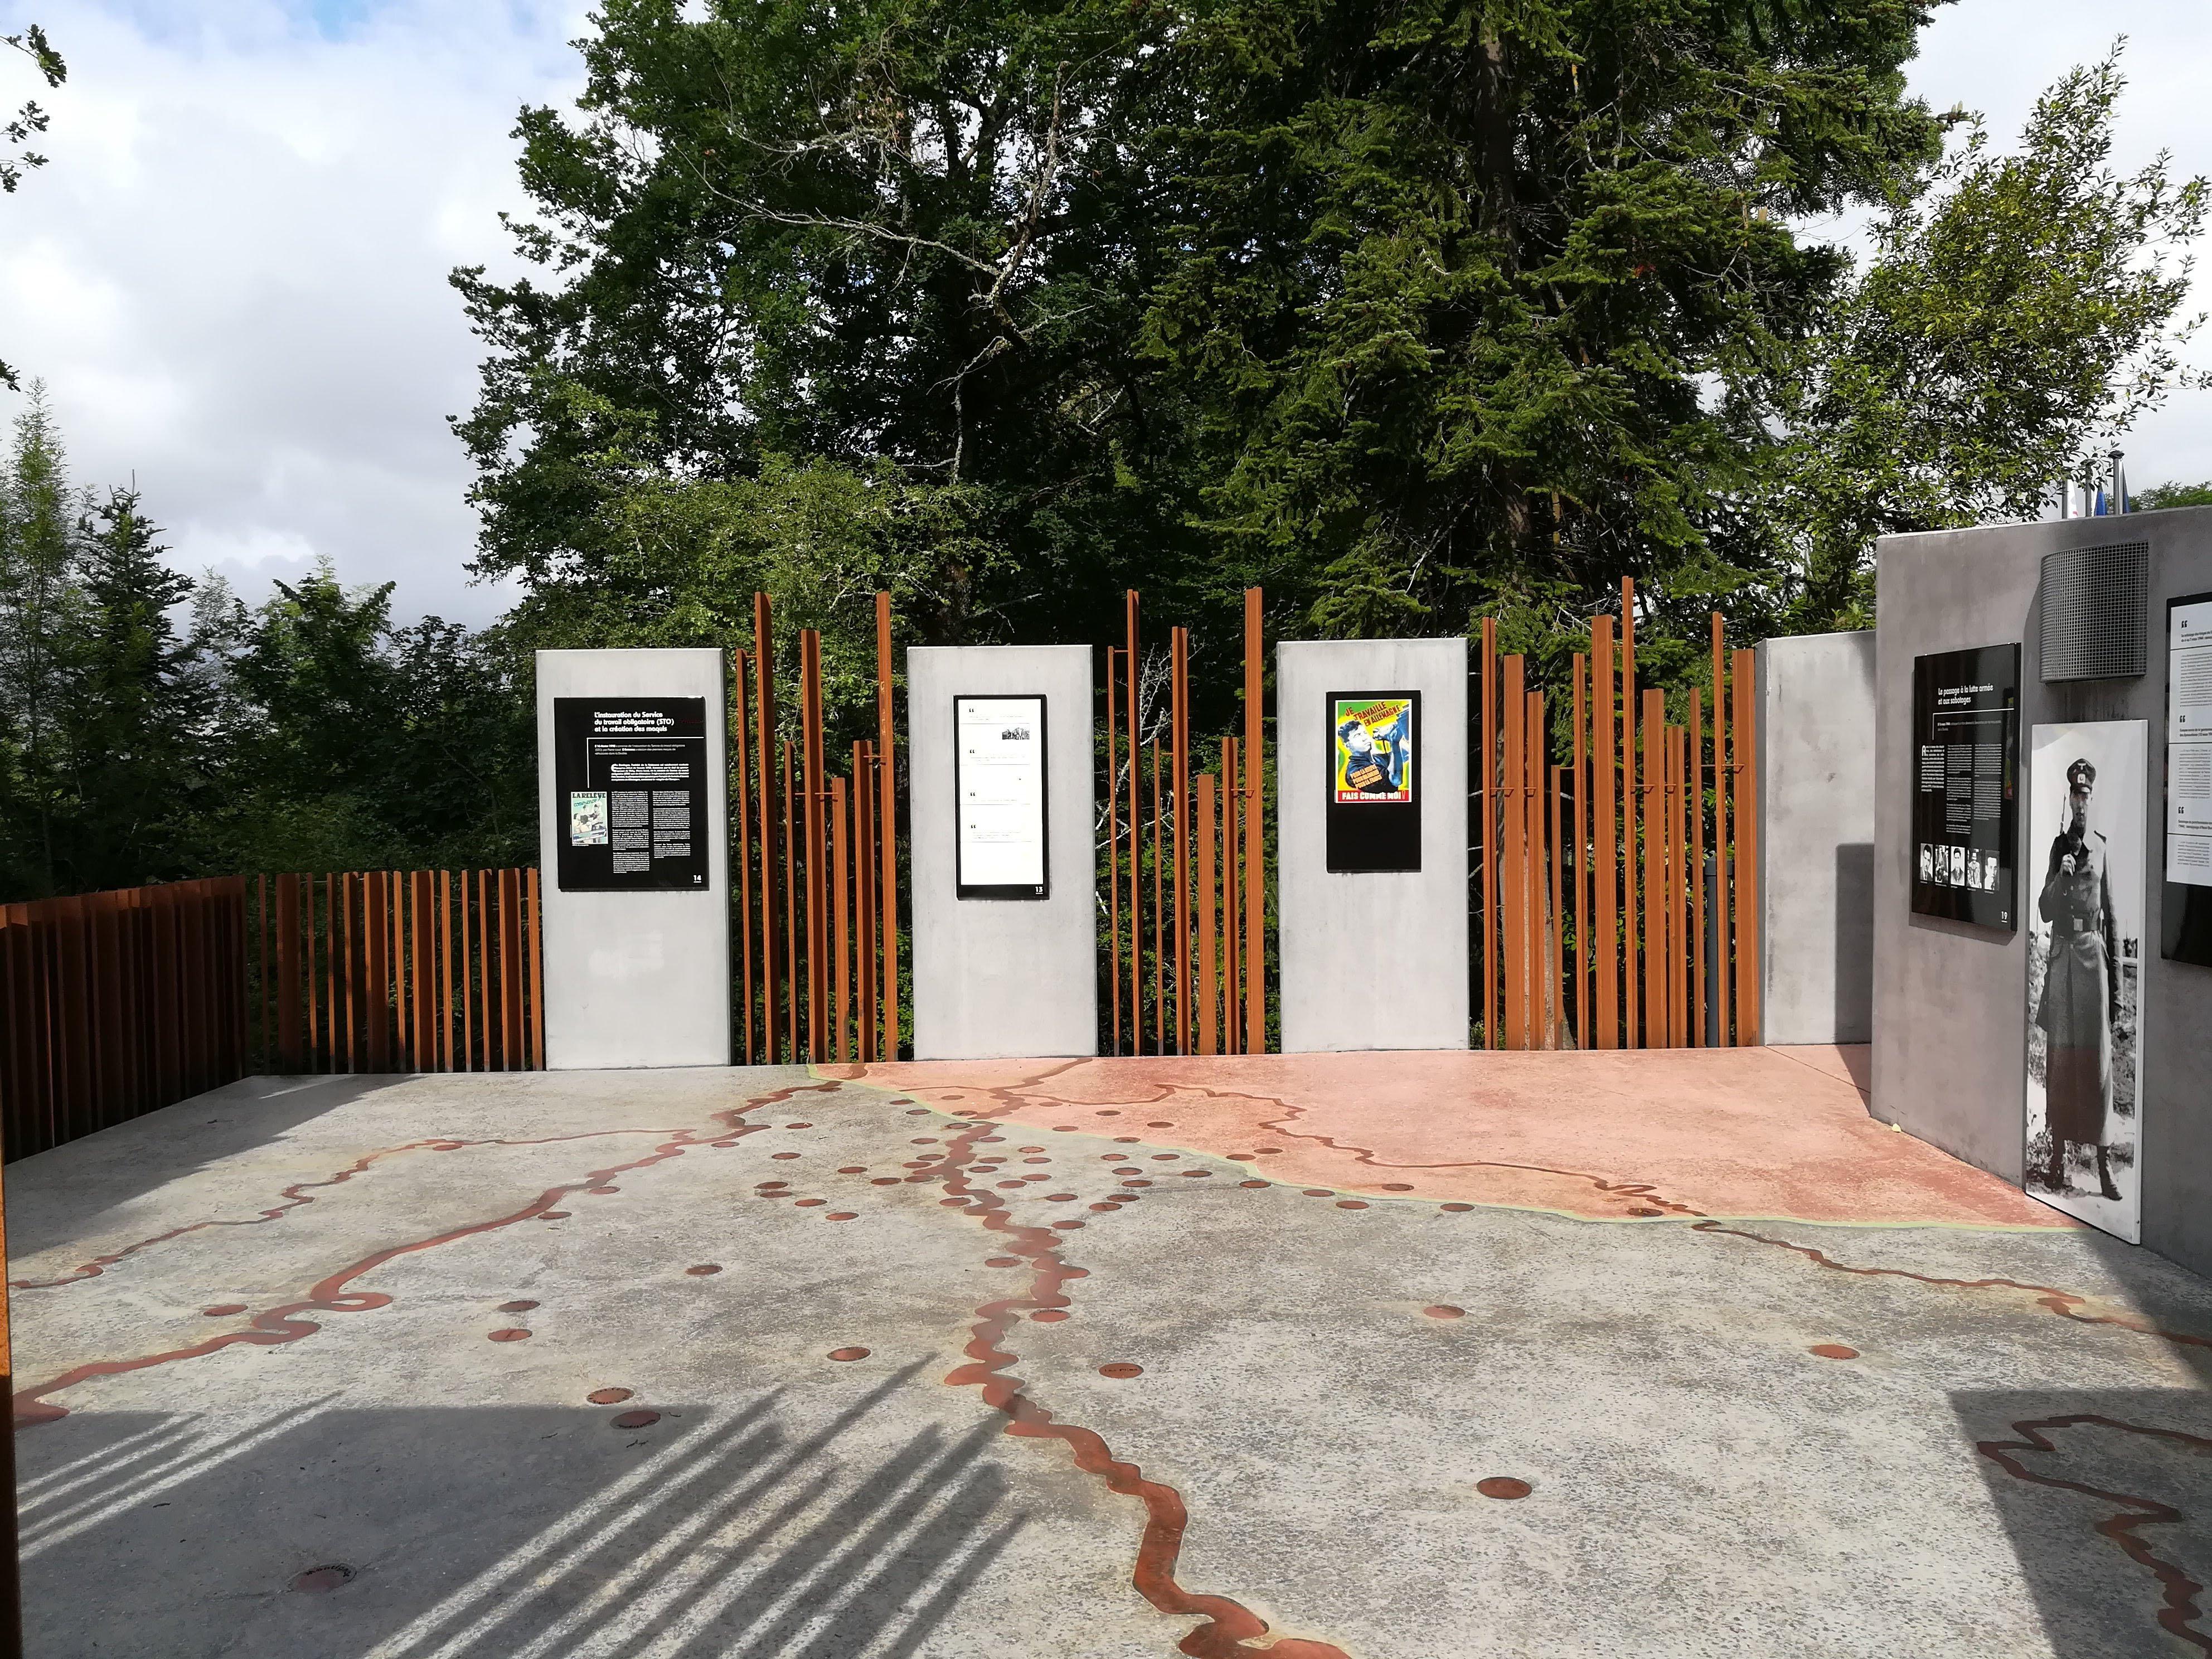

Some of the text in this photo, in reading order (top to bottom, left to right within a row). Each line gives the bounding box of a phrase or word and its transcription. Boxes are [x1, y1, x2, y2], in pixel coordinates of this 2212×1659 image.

[1943, 688, 1959, 697] passage
[1979, 683, 1993, 691] armée
[1951, 696, 1971, 705] sabotages
[1345, 706, 1354, 716] JE
[1354, 701, 1387, 720] TRAVAILLE
[1371, 705, 1401, 724] ALLEMAGNE
[1387, 791, 1401, 799] MOI
[2001, 911, 2008, 920] 19
